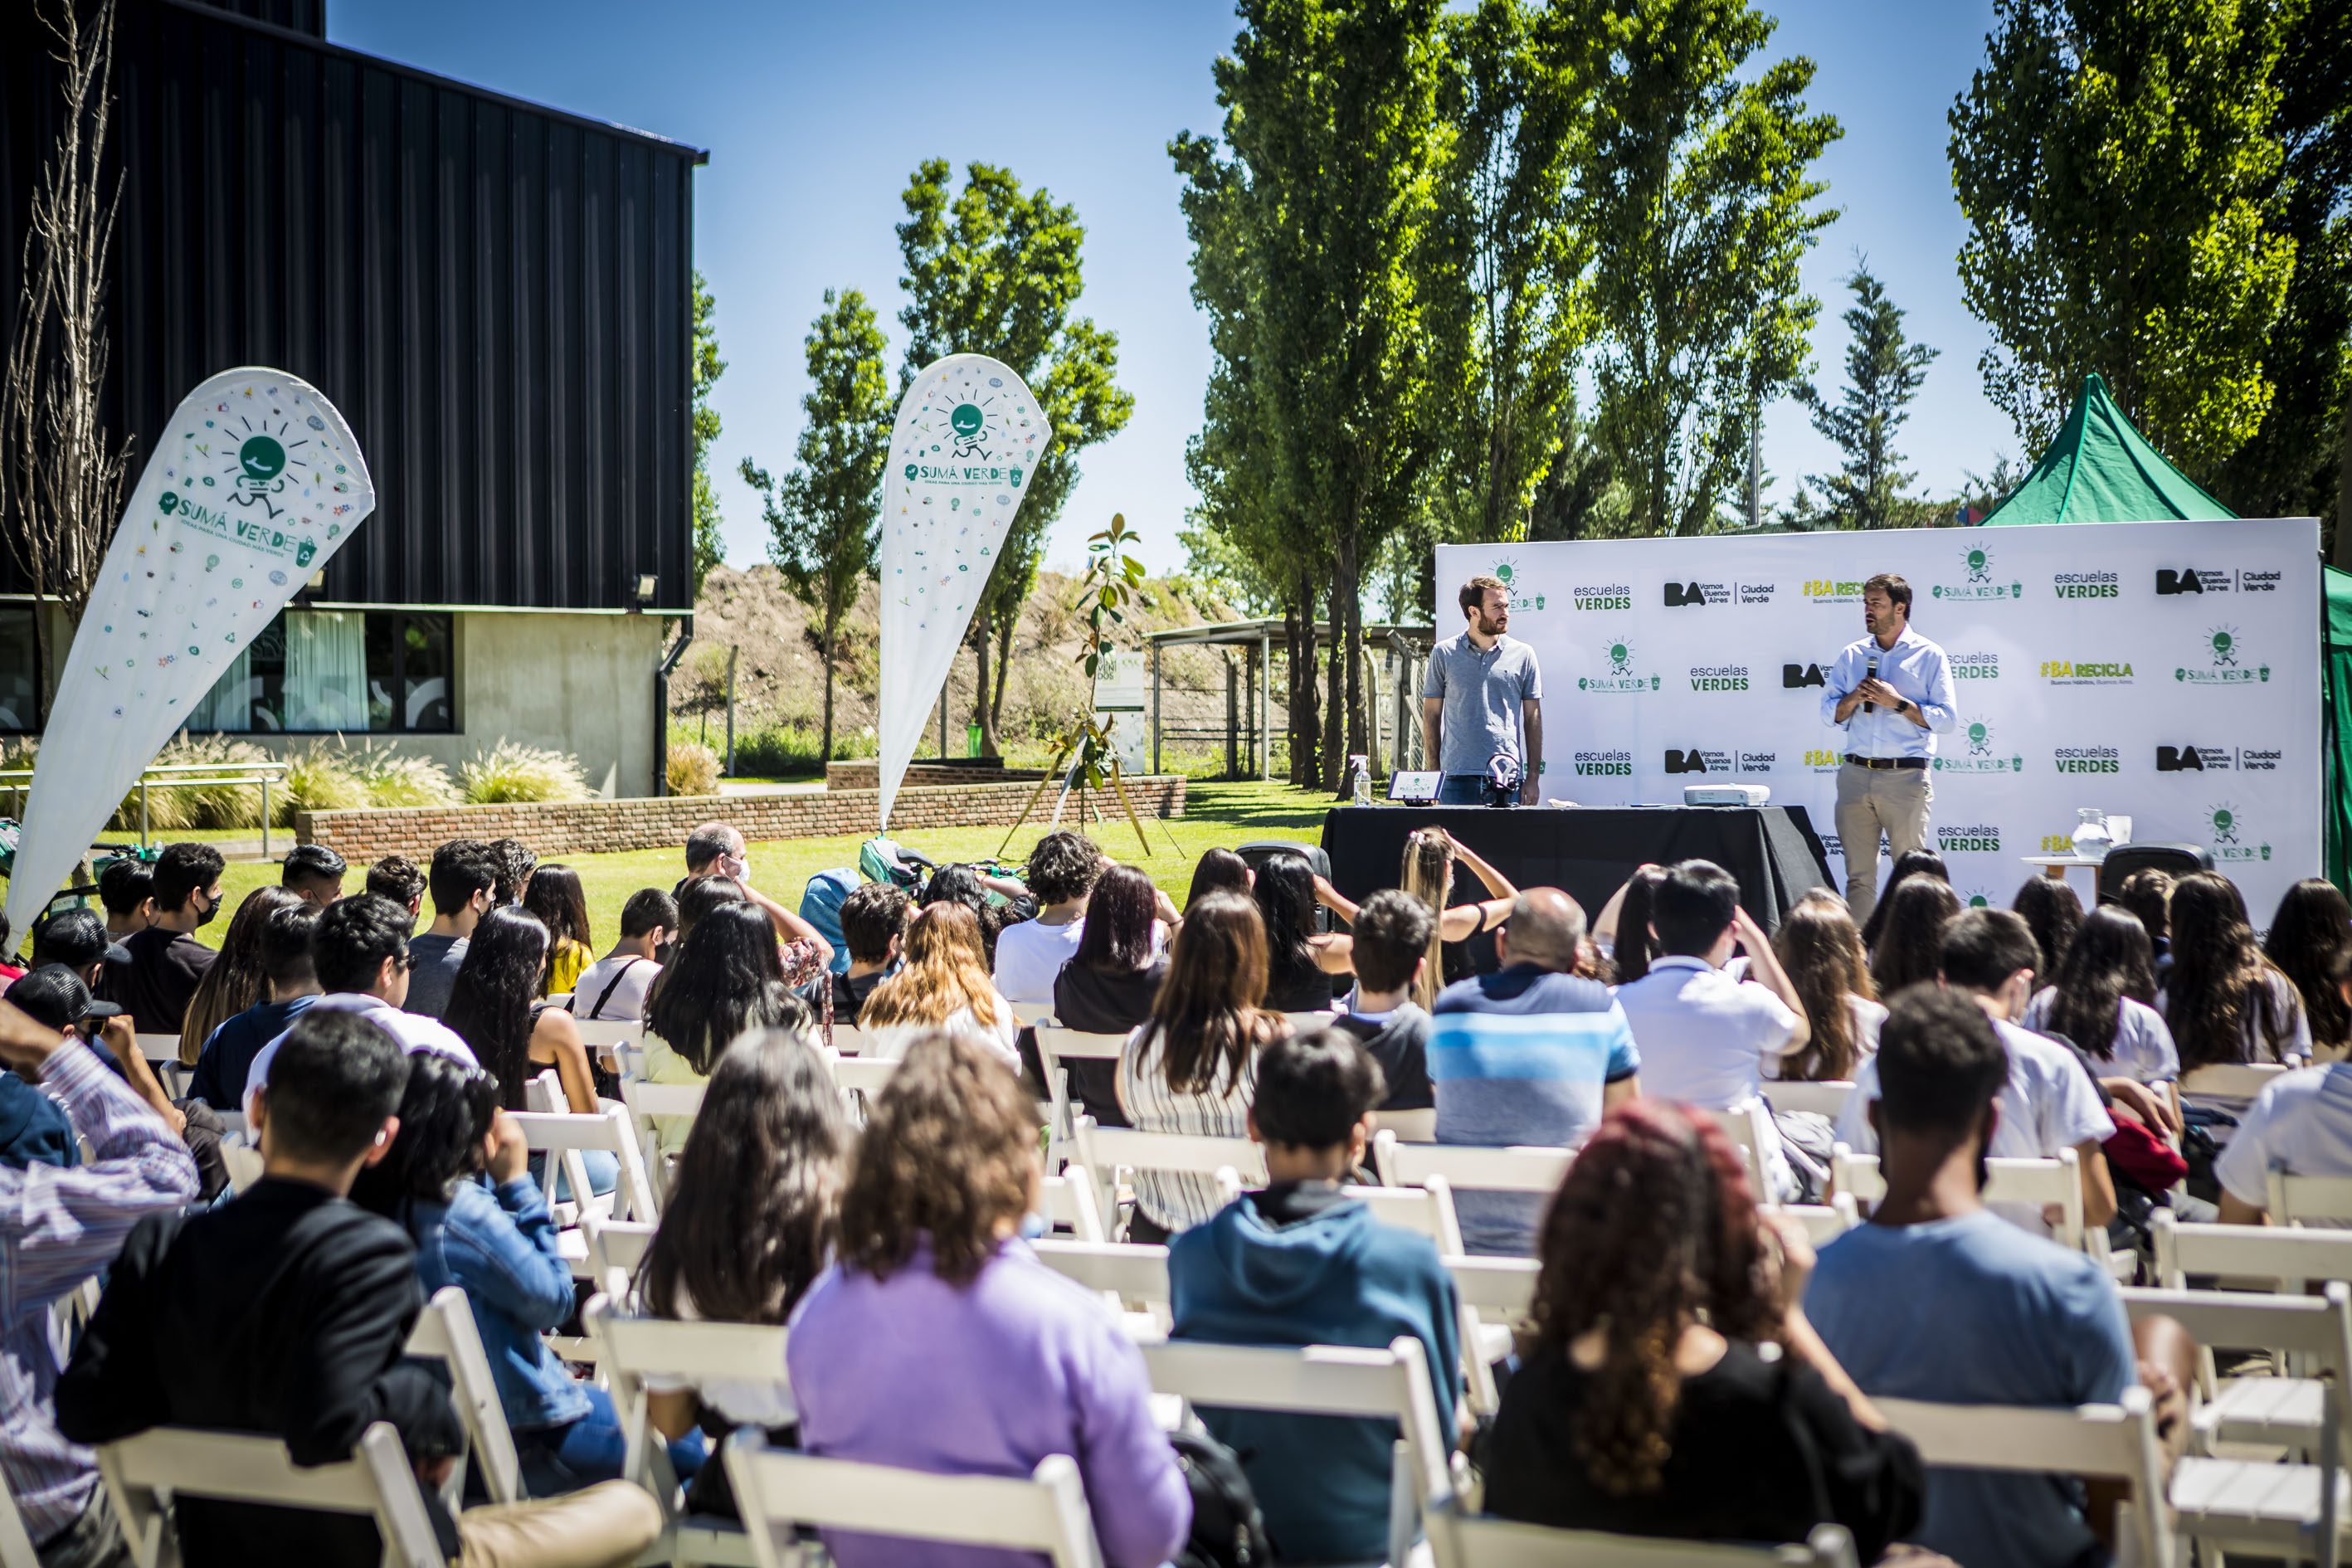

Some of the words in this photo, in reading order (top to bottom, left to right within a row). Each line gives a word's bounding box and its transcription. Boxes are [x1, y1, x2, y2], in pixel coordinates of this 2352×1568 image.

[920, 465, 958, 480] SUMÁ
[963, 468, 1008, 480] VERDE
[178, 499, 228, 531] SUMÁ
[237, 519, 297, 553] VERDE
[181, 519, 197, 529] IDEAS
[198, 525, 214, 536] PARA
[215, 532, 227, 540] UNA
[228, 537, 251, 548] CIUDAD
[265, 548, 285, 558] VERDE
[2054, 571, 2118, 583] escuelas
[2156, 568, 2203, 595] BA
[2243, 571, 2281, 581] Ciudad
[1574, 583, 1630, 597] escuelas
[1741, 584, 1775, 593] Ciudad
[1836, 582, 1865, 596] RECI
[1976, 586, 2010, 597] VERDE
[2055, 584, 2119, 598] VERDES
[2243, 582, 2275, 592] Verde
[1664, 582, 1706, 606] BA
[1741, 594, 1770, 603] Verde
[1508, 597, 1534, 609] ERDE
[1574, 597, 1631, 611] VERDES
[1946, 651, 1999, 664] scuelas
[1691, 665, 1748, 676] escuelas
[1783, 664, 1826, 688] BA
[1950, 665, 1999, 679] ERDES
[2075, 663, 2134, 677] RECICLA
[2222, 669, 2257, 680] VERDE
[1589, 678, 1615, 689] SUMÁ
[1619, 678, 1649, 689] VERDE
[1691, 677, 1749, 691] VERDES
[1575, 749, 1631, 761] escuelas
[1742, 752, 1775, 762] Ciudad
[2055, 745, 2119, 757] escuelas
[2243, 750, 2281, 759] Ciudad
[1664, 749, 1707, 773] BA
[1977, 758, 2011, 769] VERDE
[2156, 746, 2203, 772] BA
[2243, 761, 2276, 770] Verde
[1575, 762, 1632, 776] VERDES
[1741, 763, 1770, 772] Verde
[2056, 759, 2119, 773] VERDES
[1937, 824, 1999, 837] escuelas
[1937, 838, 2000, 851] VERDES
[2223, 846, 2259, 858] VERDE
